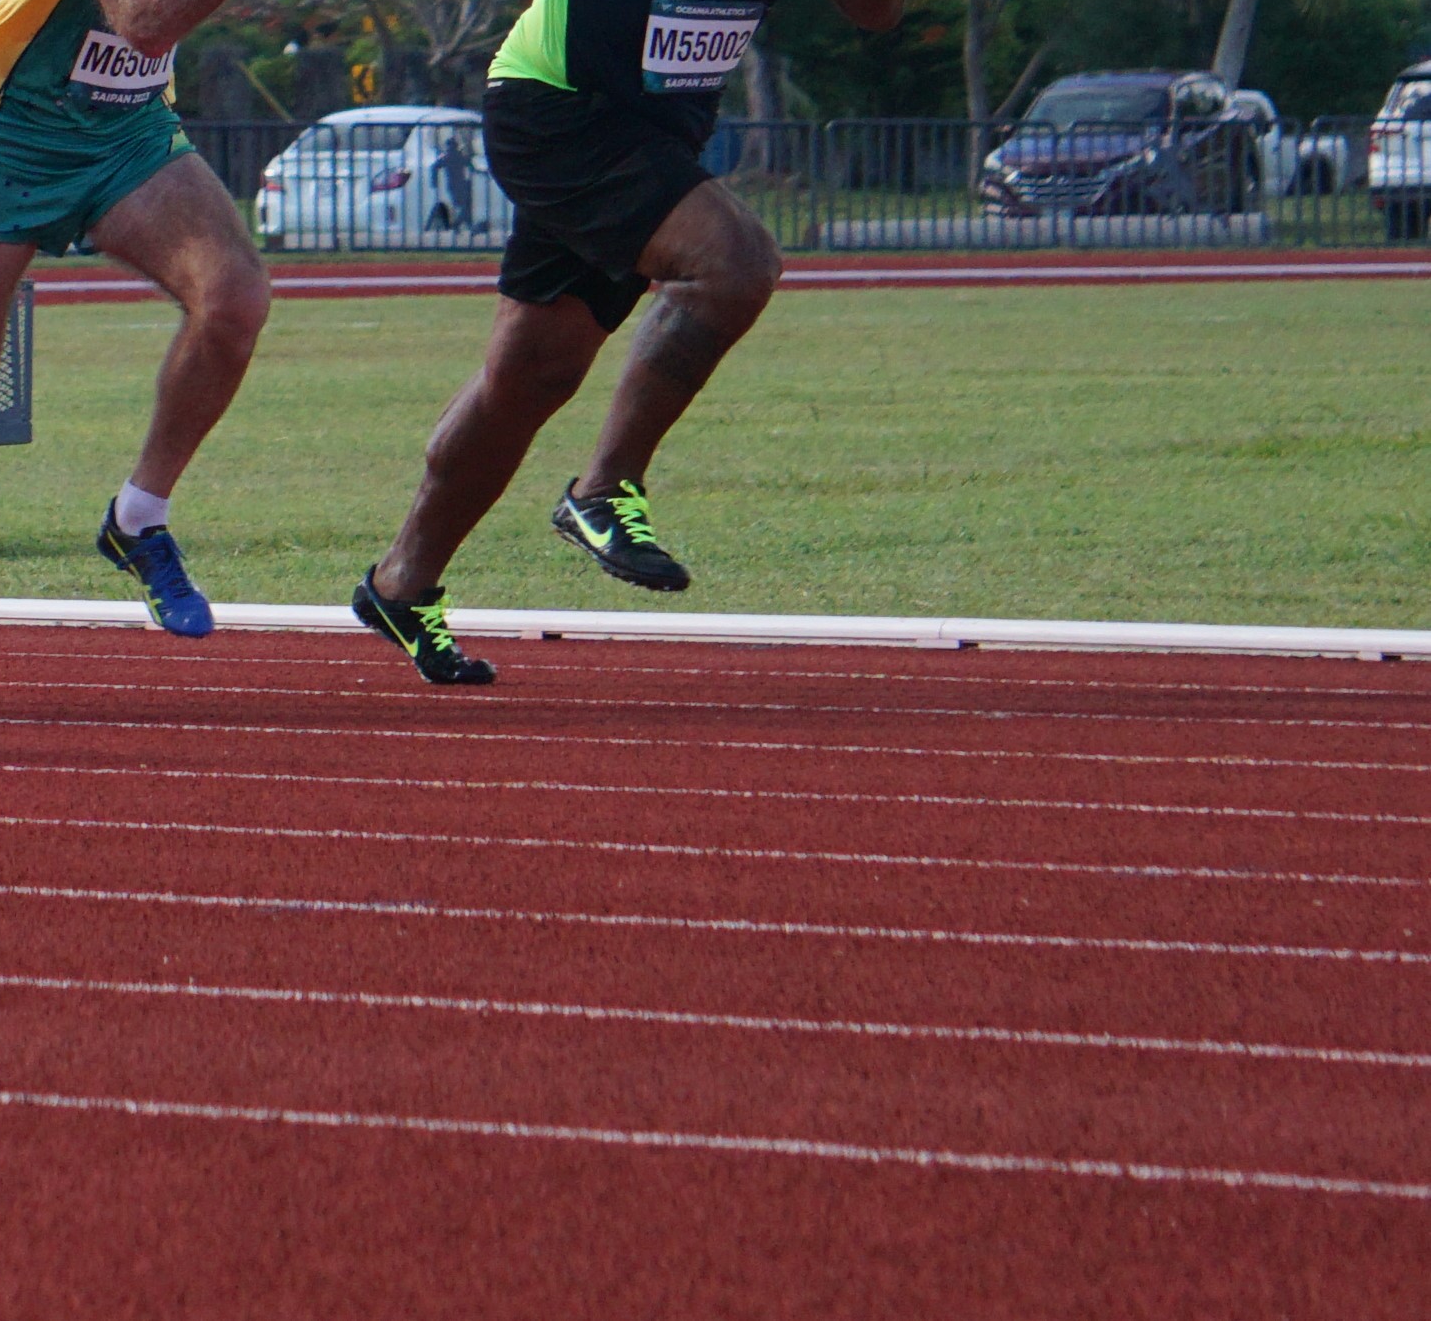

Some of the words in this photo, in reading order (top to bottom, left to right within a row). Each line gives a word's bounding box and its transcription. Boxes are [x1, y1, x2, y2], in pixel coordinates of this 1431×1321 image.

[649, 27, 752, 62] M55002
[663, 78, 700, 88] SAIPAN
[91, 91, 133, 103] SAIPAN
